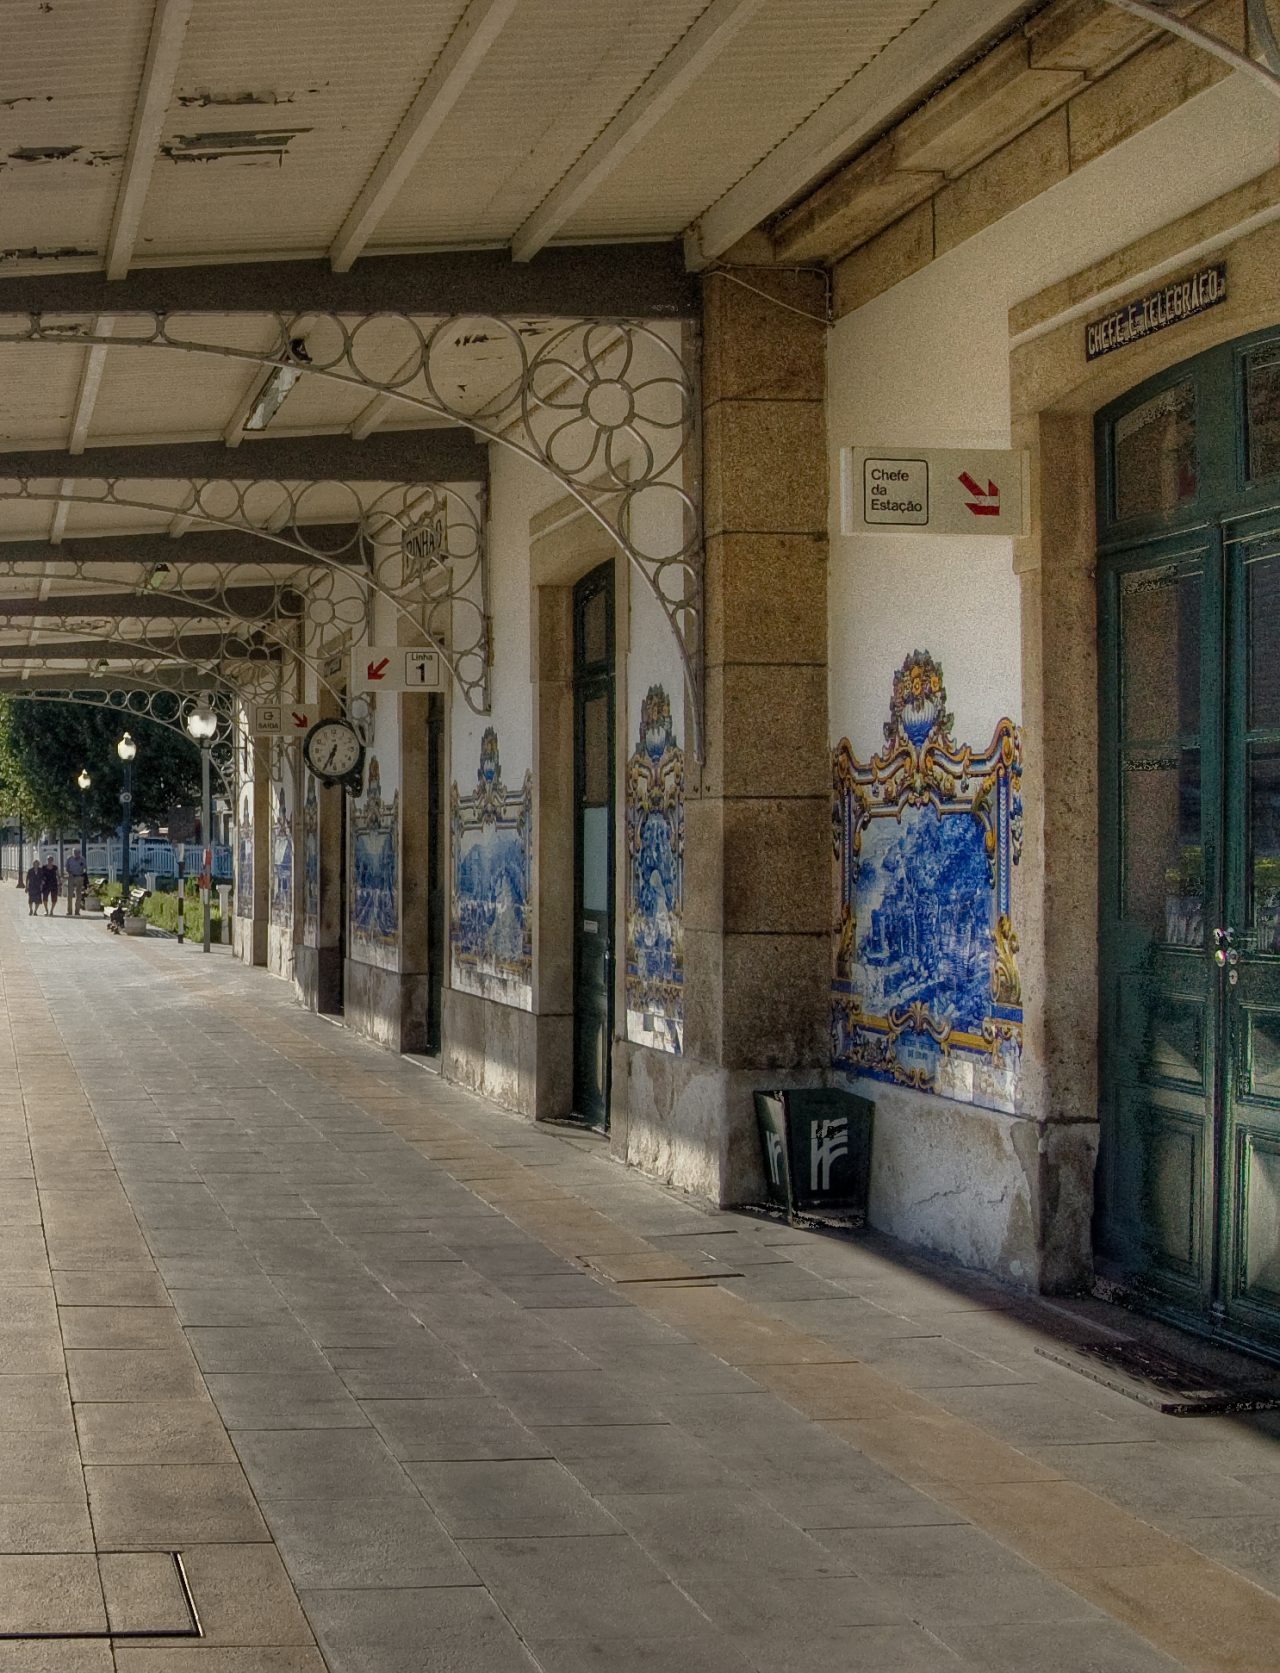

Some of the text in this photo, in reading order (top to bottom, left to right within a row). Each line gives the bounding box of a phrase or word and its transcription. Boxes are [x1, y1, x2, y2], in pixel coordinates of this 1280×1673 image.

[1088, 313, 1124, 355] CHEFE
[1128, 306, 1137, 337] E
[871, 468, 910, 482] Chefe
[871, 483, 887, 496] da
[871, 498, 923, 514] Estação
[411, 652, 433, 661] Linha
[415, 662, 426, 683] 1
